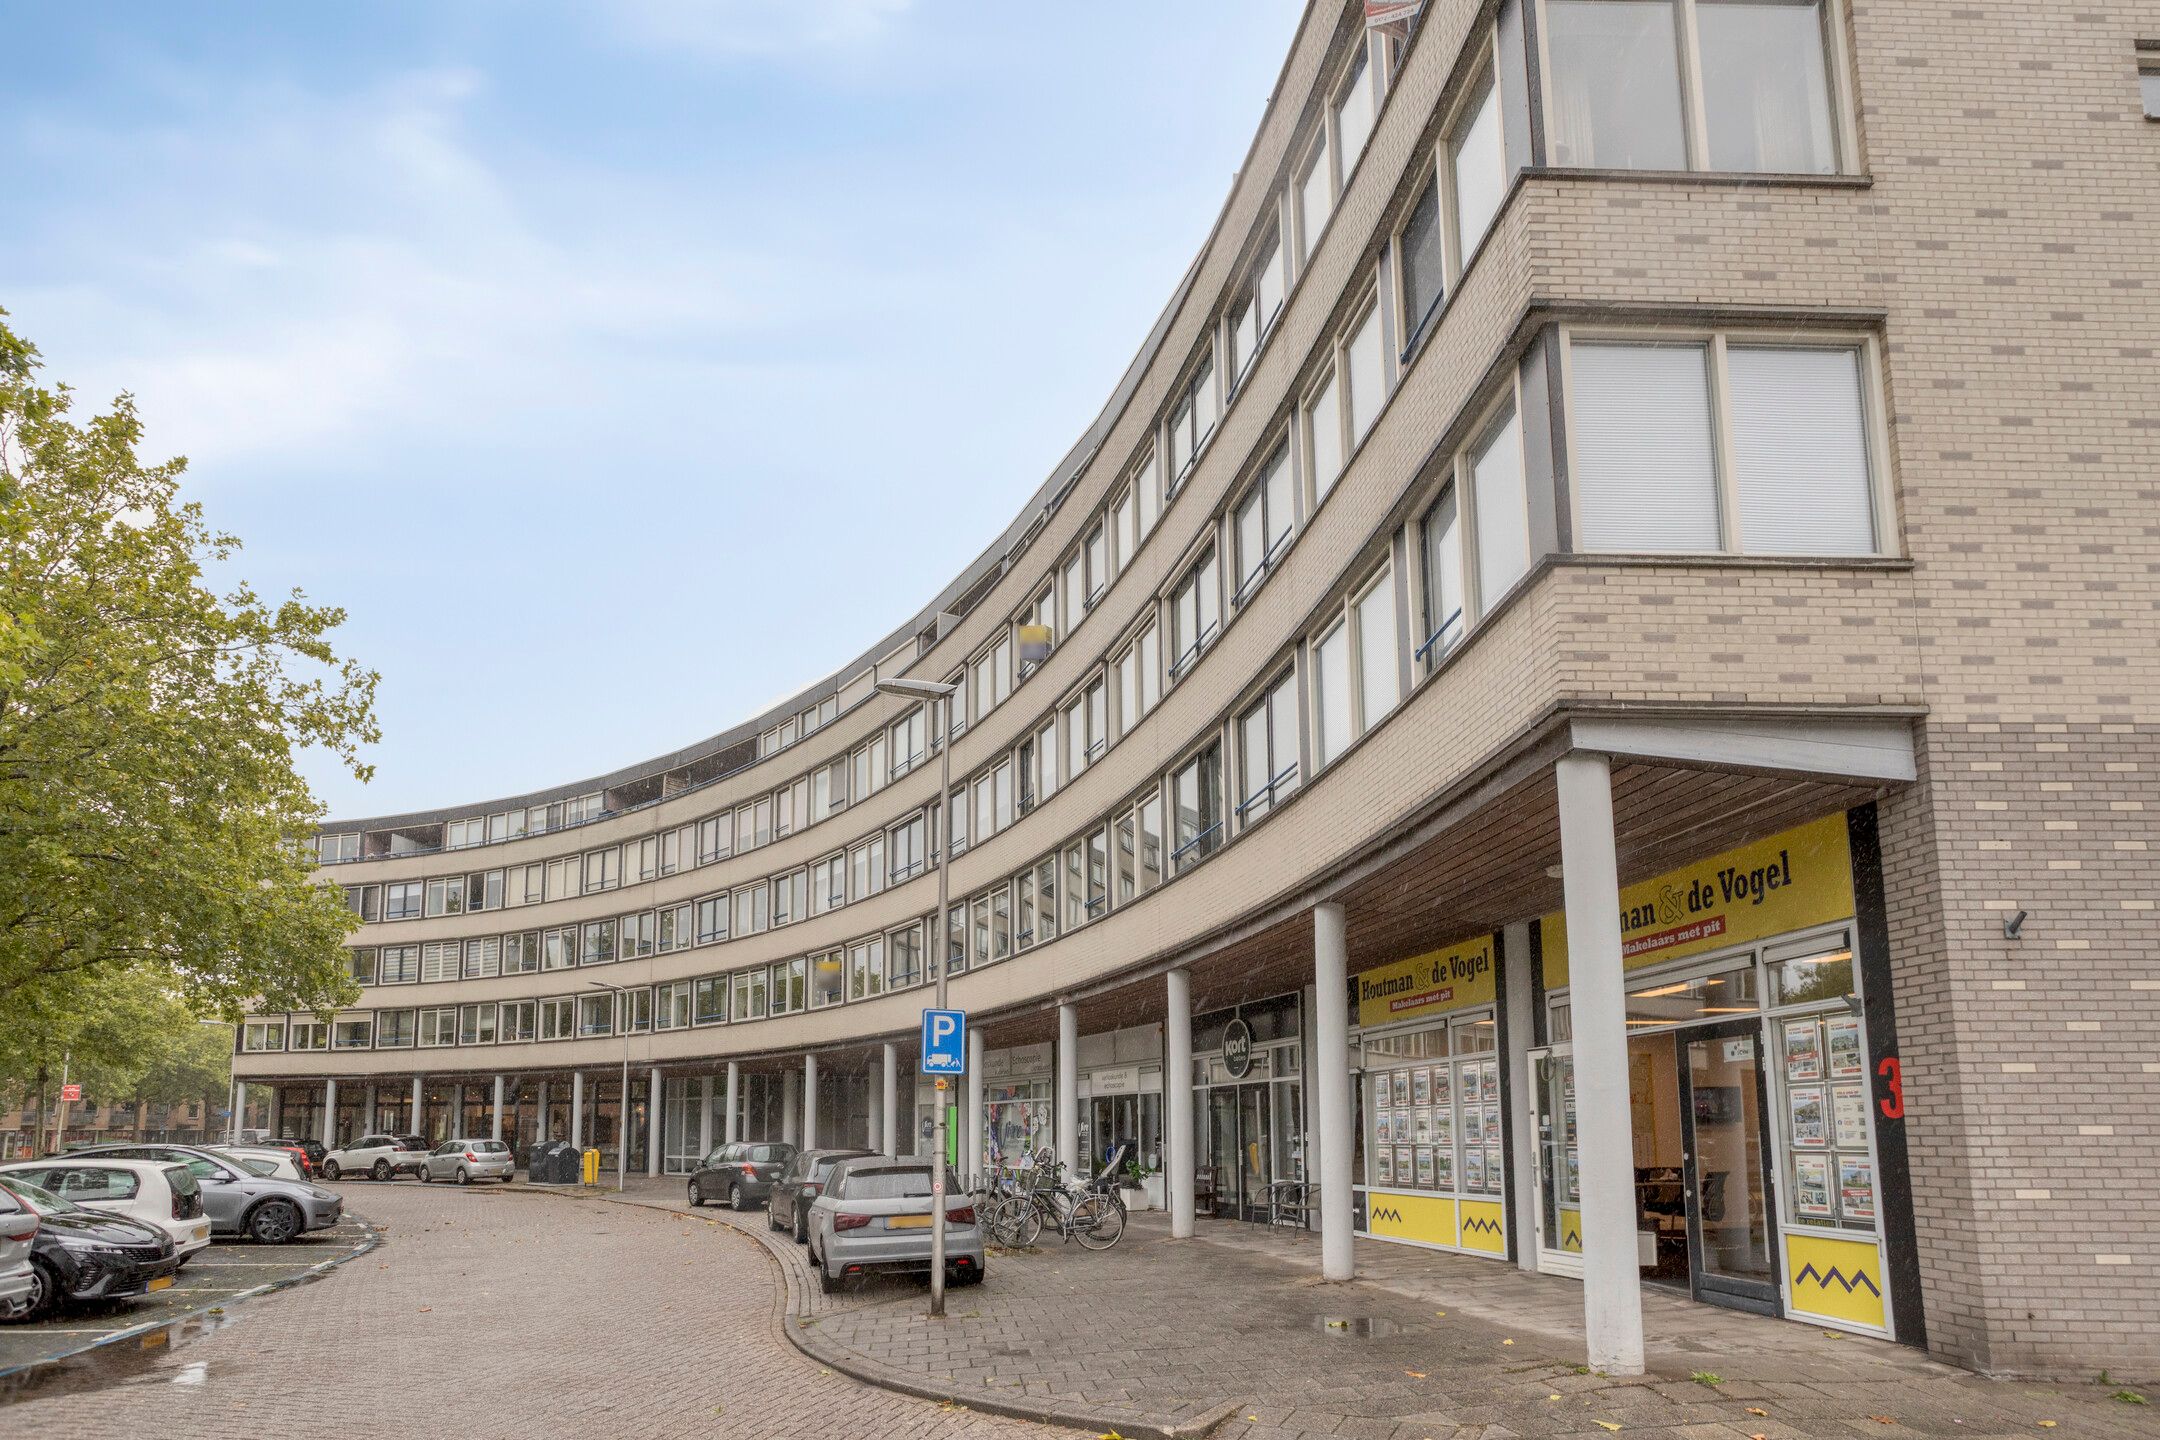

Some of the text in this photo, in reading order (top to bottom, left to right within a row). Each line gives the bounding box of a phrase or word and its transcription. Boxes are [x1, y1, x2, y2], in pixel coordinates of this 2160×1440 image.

[1659, 884, 1684, 925] &
[1687, 879, 1714, 914] de
[1717, 849, 1792, 905] Vogel
[1622, 920, 1721, 954] Makelaars met pit
[1362, 947, 1489, 1001] Houtman & de Vogel
[1392, 990, 1451, 1010] Makelaars met pit
[933, 1015, 955, 1047] P
[1878, 1057, 1904, 1118] 3
